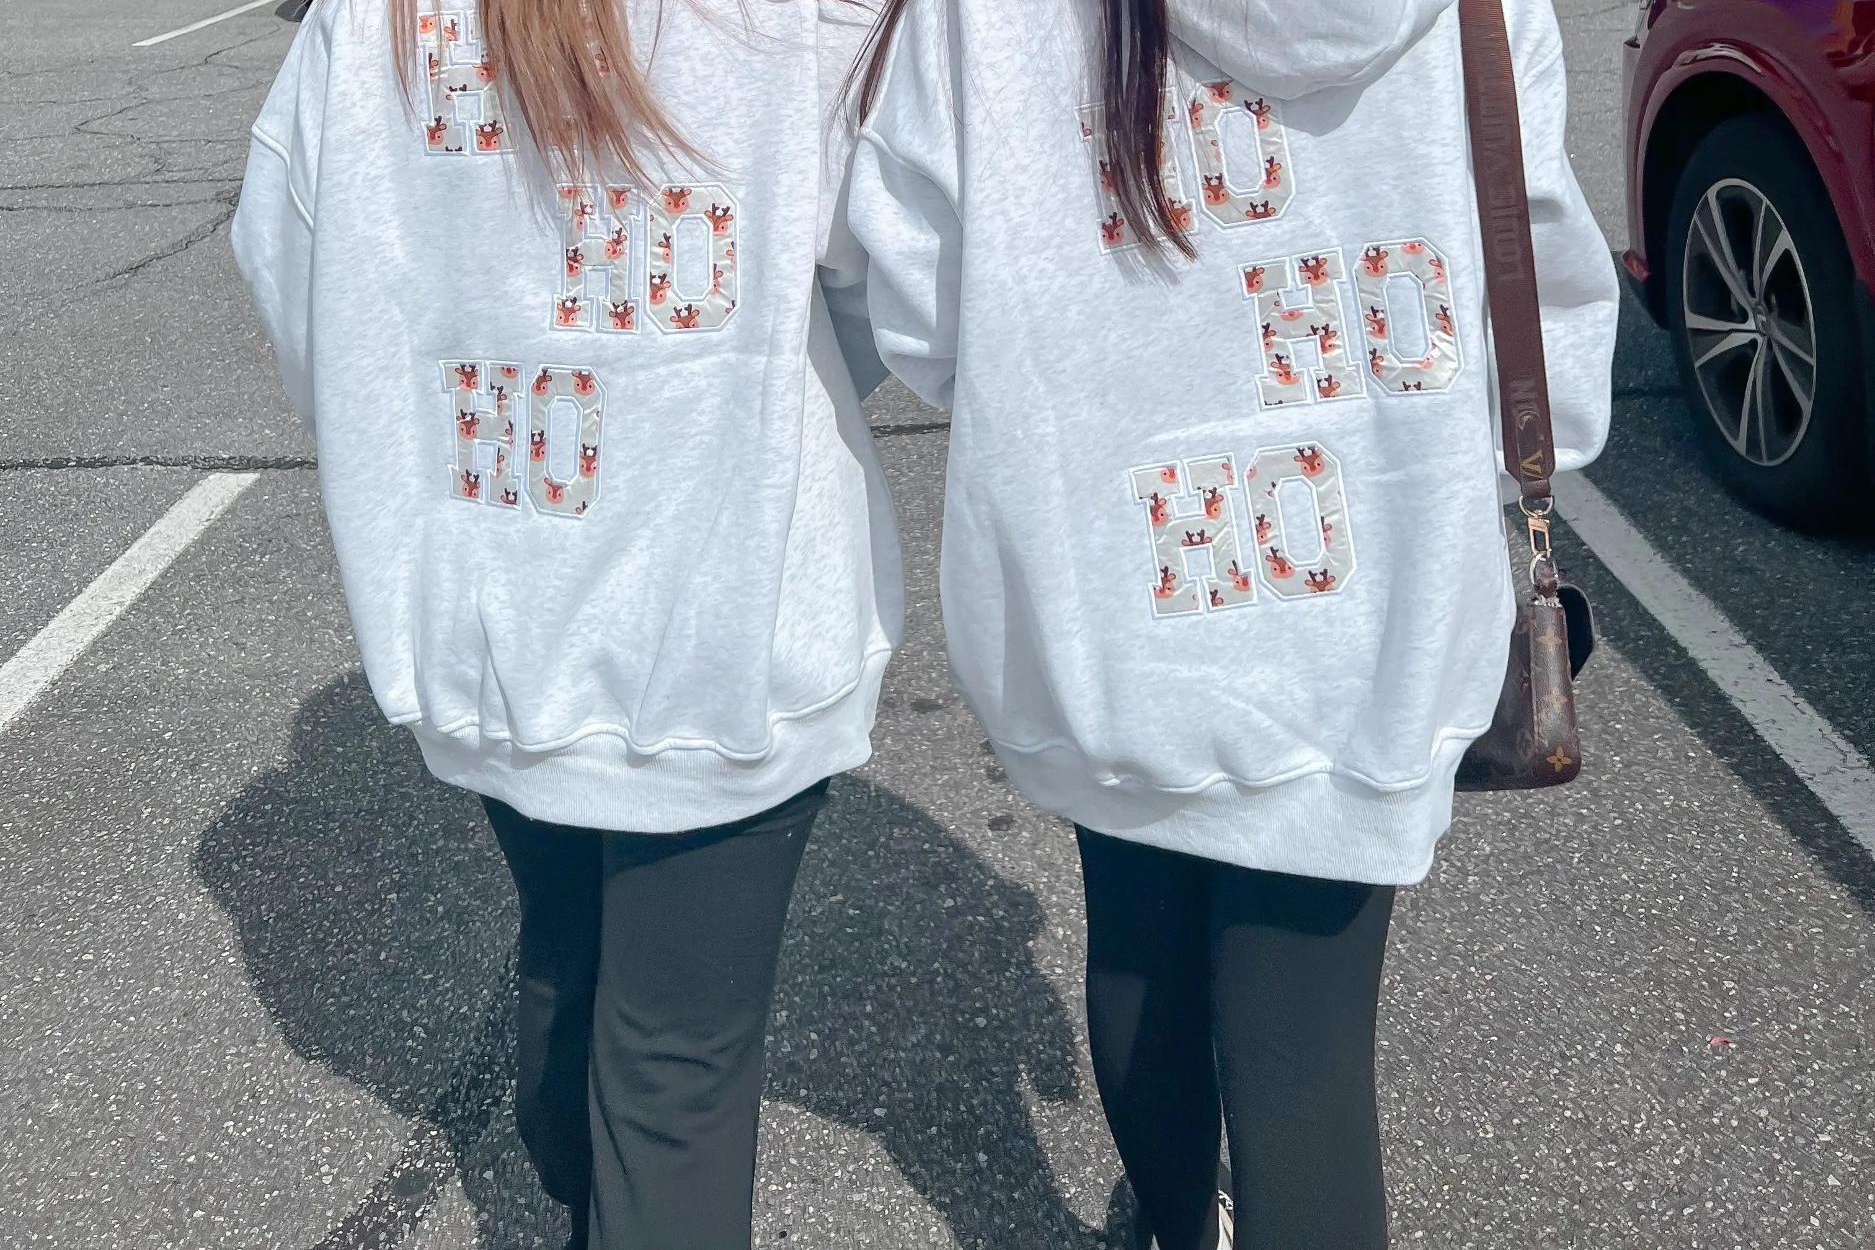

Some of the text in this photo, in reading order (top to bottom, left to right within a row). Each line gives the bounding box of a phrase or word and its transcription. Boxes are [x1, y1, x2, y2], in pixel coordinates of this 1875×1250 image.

[549, 181, 742, 334] HO
[1238, 236, 1466, 411] HO
[439, 358, 607, 518] HO
[1129, 440, 1358, 620] HO
